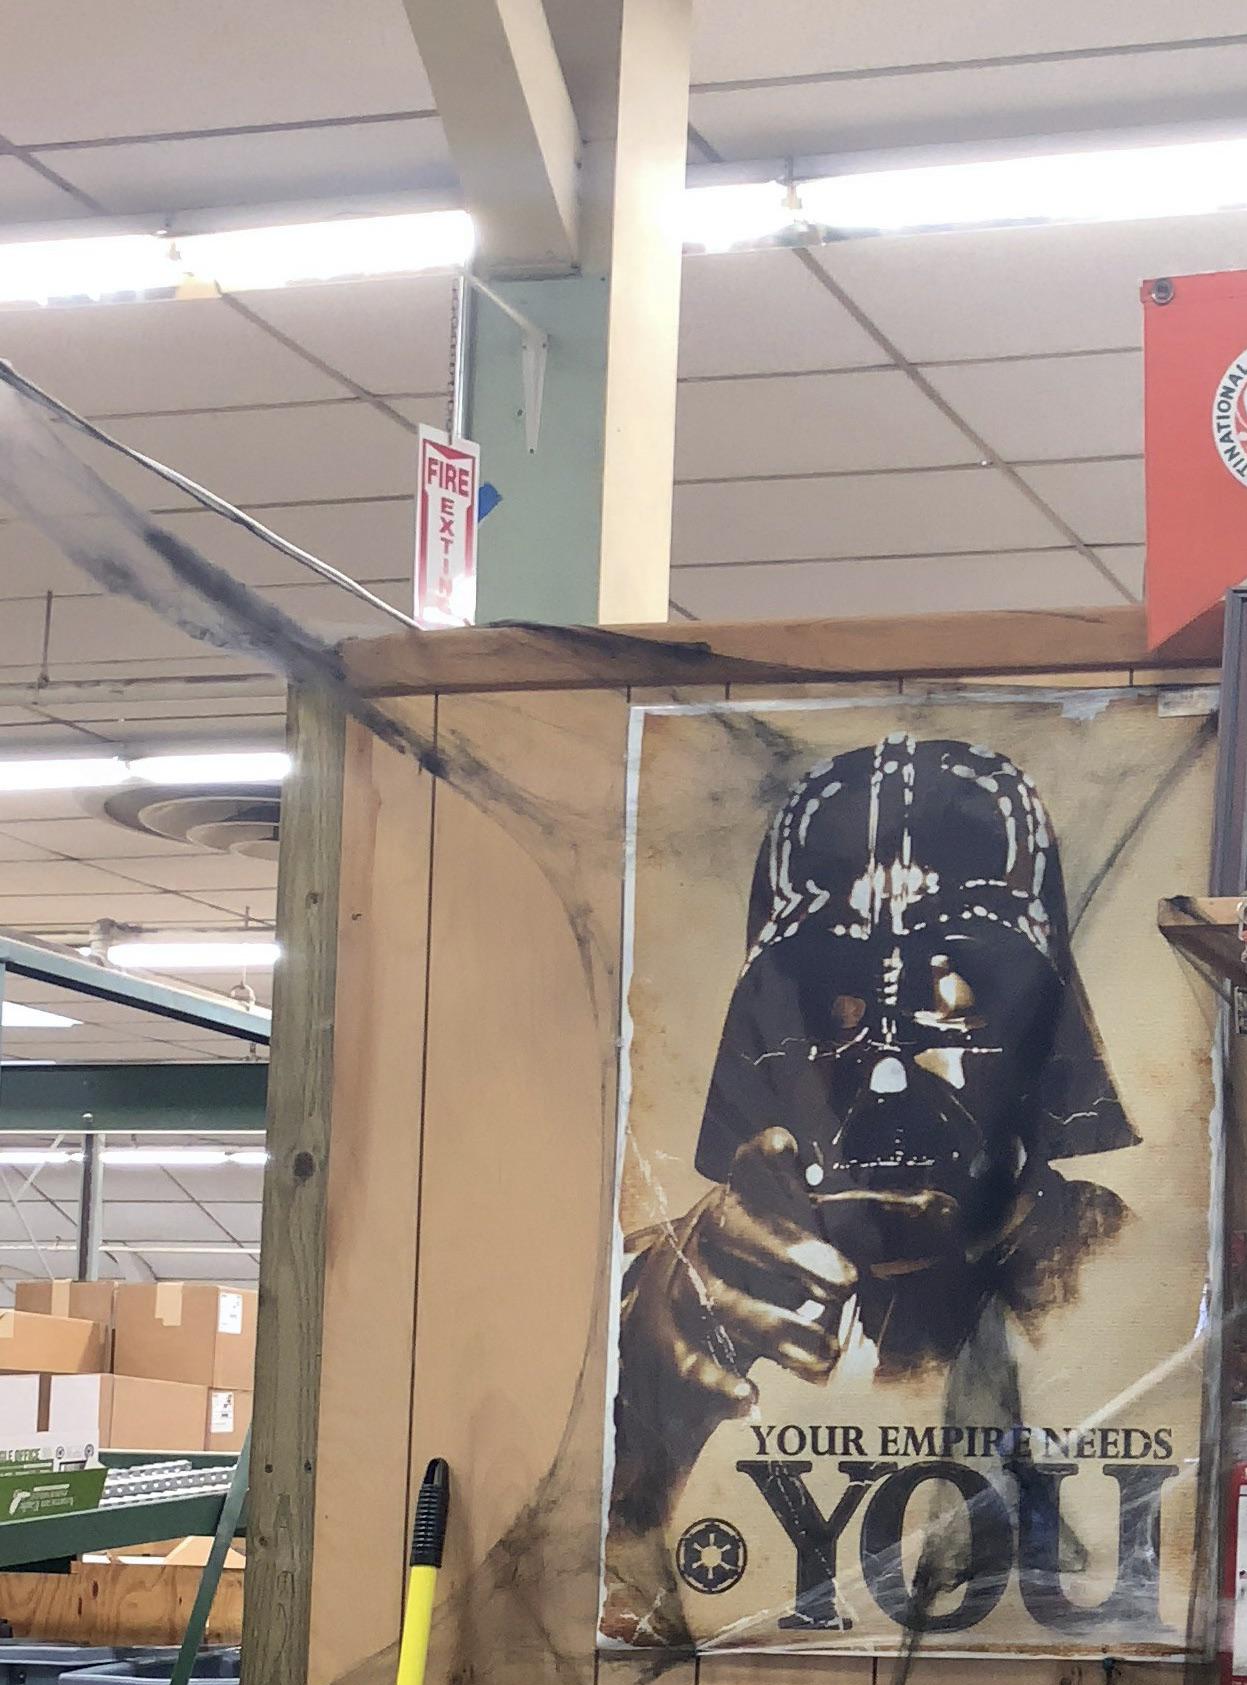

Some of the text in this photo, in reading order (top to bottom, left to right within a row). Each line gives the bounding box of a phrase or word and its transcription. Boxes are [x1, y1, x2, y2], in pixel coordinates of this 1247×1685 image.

[428, 456, 470, 498] FIRE
[750, 1425, 1173, 1460] YOUR EMPIRE NEEDS
[736, 1460, 1180, 1634] YOU
